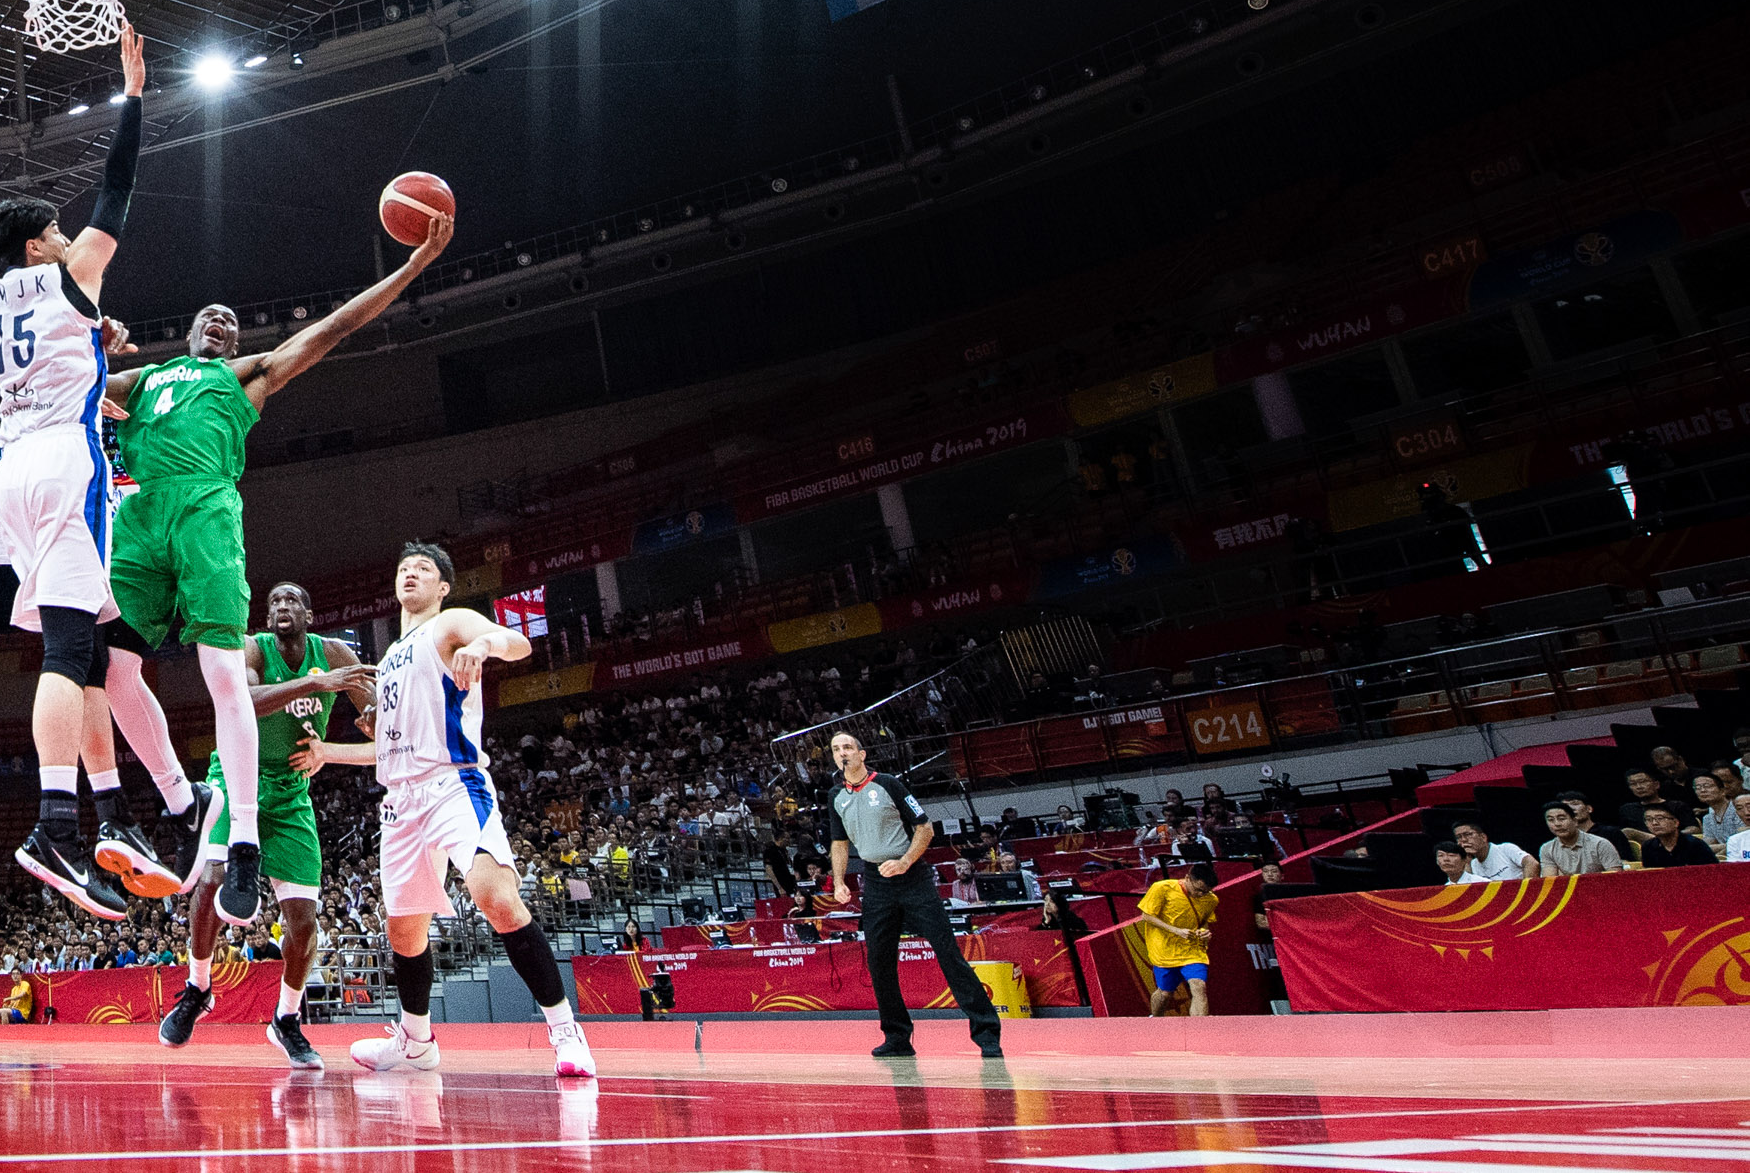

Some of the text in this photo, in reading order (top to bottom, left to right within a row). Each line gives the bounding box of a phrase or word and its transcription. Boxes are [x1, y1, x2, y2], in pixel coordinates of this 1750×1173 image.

[1422, 238, 1481, 275] C417
[17, 279, 26, 299] J
[35, 274, 46, 294] K
[1297, 315, 1372, 353] WUHAN
[144, 364, 202, 392] NIGERIA
[153, 386, 175, 416] 4
[838, 436, 875, 461] C416
[1395, 424, 1459, 461] C304
[764, 417, 1029, 510] FIBA BASKETBALL WORLD CUP China 2019
[931, 589, 981, 612] WUHAN
[379, 644, 413, 676] OREA
[612, 641, 743, 680] THE WORLD'S GOT GAME
[382, 682, 398, 713] 33
[1128, 707, 1163, 723] GAME!
[1194, 711, 1262, 745] C214
[769, 957, 789, 968] China
[791, 947, 807, 955] WORLD
